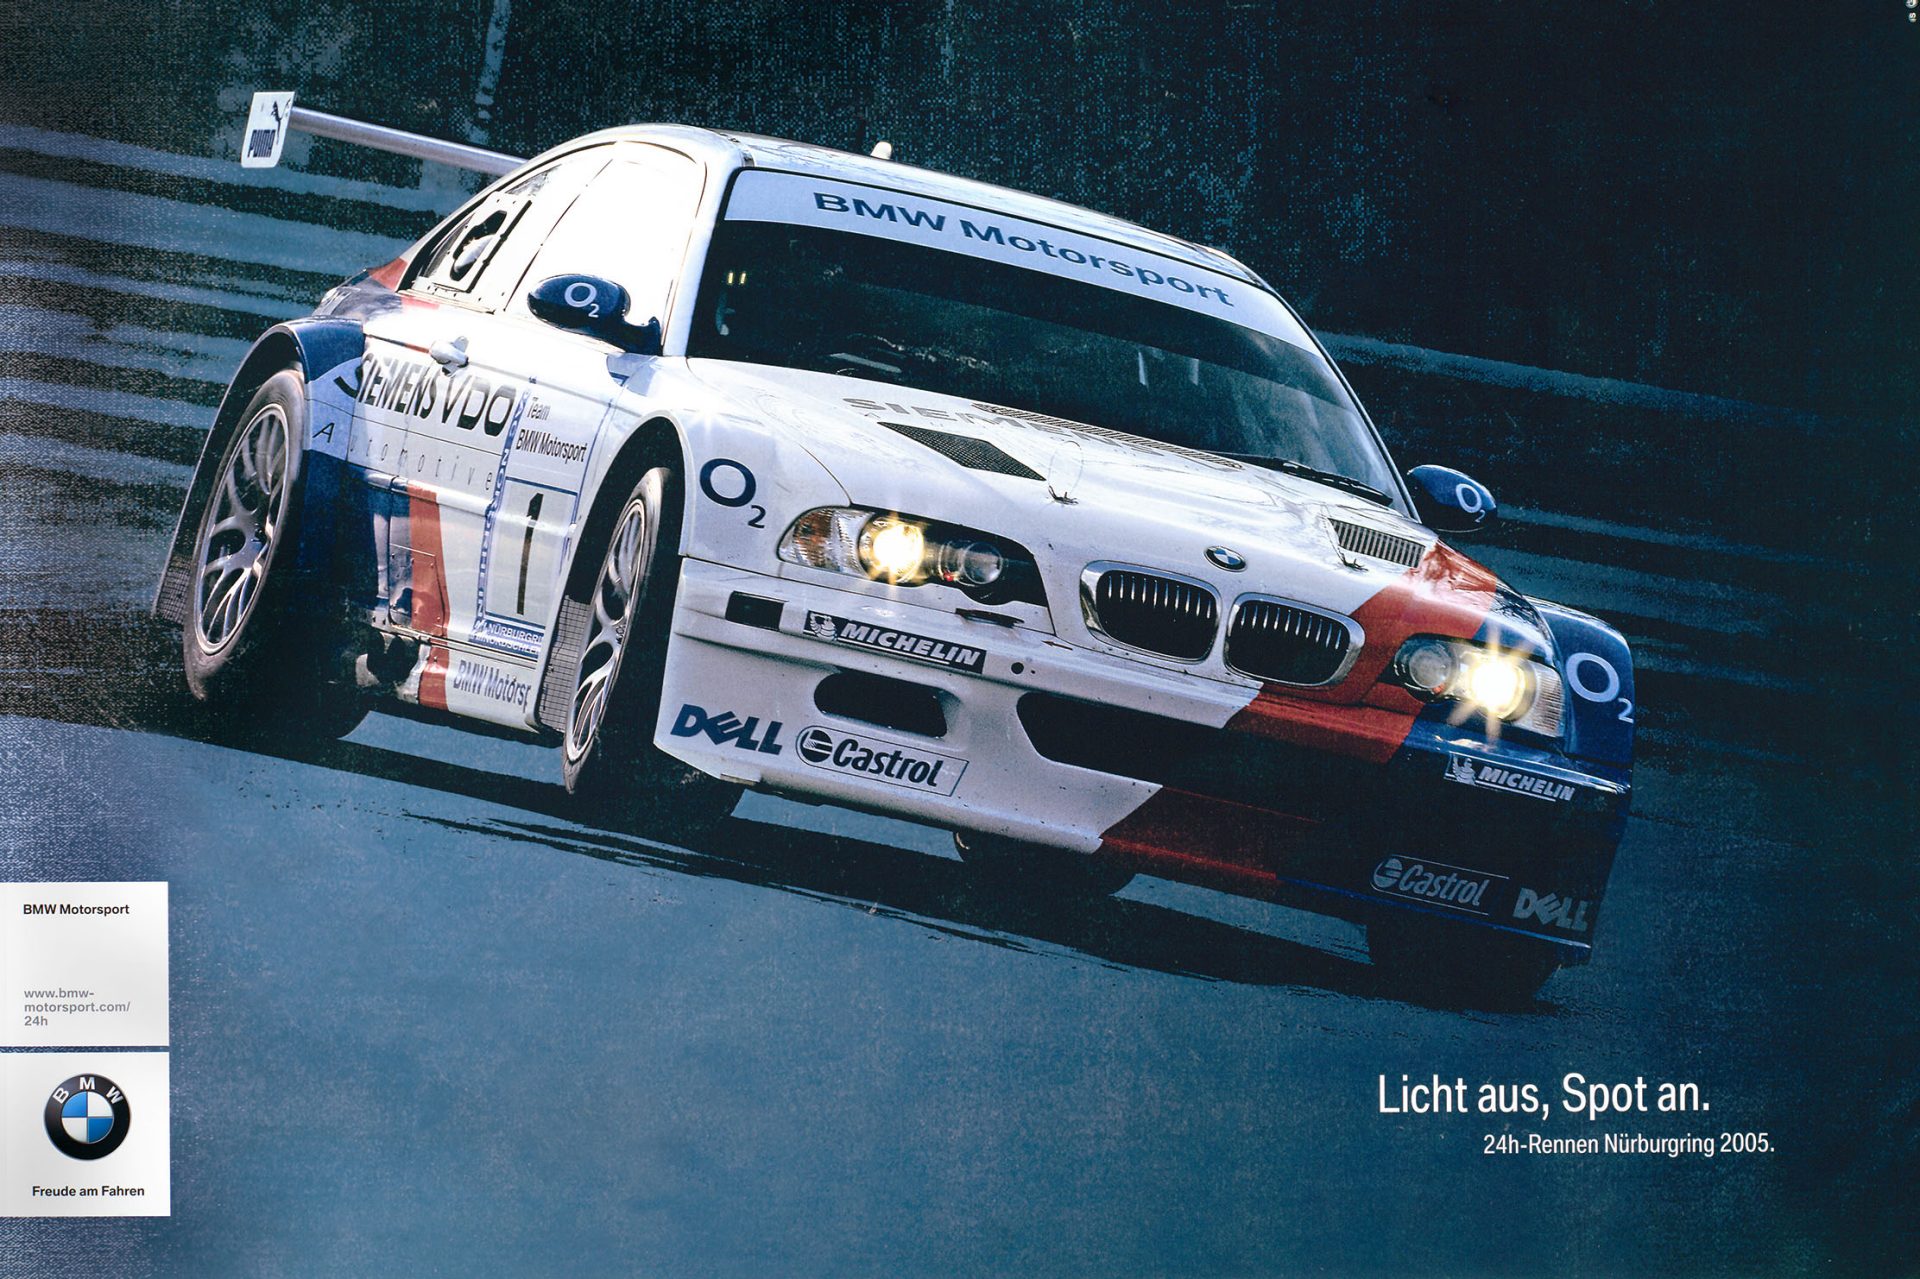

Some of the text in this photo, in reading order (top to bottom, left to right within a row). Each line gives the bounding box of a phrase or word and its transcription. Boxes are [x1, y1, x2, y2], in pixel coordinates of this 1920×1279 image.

[813, 191, 1235, 307] BMW Motorsport
[333, 352, 517, 437] SIEMENS VDO
[527, 396, 551, 421] Team
[842, 397, 1165, 457] SIEMENS
[515, 428, 588, 465] BMW Motorsport
[516, 492, 544, 615] 1
[839, 622, 981, 666] MICHELIN
[453, 659, 488, 695] BMW
[671, 703, 783, 755] DELL
[832, 738, 945, 787] Castrol
[1478, 766, 1576, 801] MICHELIN
[1398, 864, 1490, 906] Castrol
[23, 904, 130, 917] BMW Motorsport
[1512, 887, 1591, 932] DELL
[24, 988, 95, 998] www.bmw-
[24, 1002, 130, 1014] motorsport.com/
[24, 1016, 48, 1026] 24h
[52, 1077, 124, 1104] BMW
[1378, 1072, 1711, 1121] Licht aus, Spot an.
[1483, 1132, 1775, 1158] 24h-Rennen Nürburgring 2005.
[32, 1186, 145, 1197] Freude am Fahren
